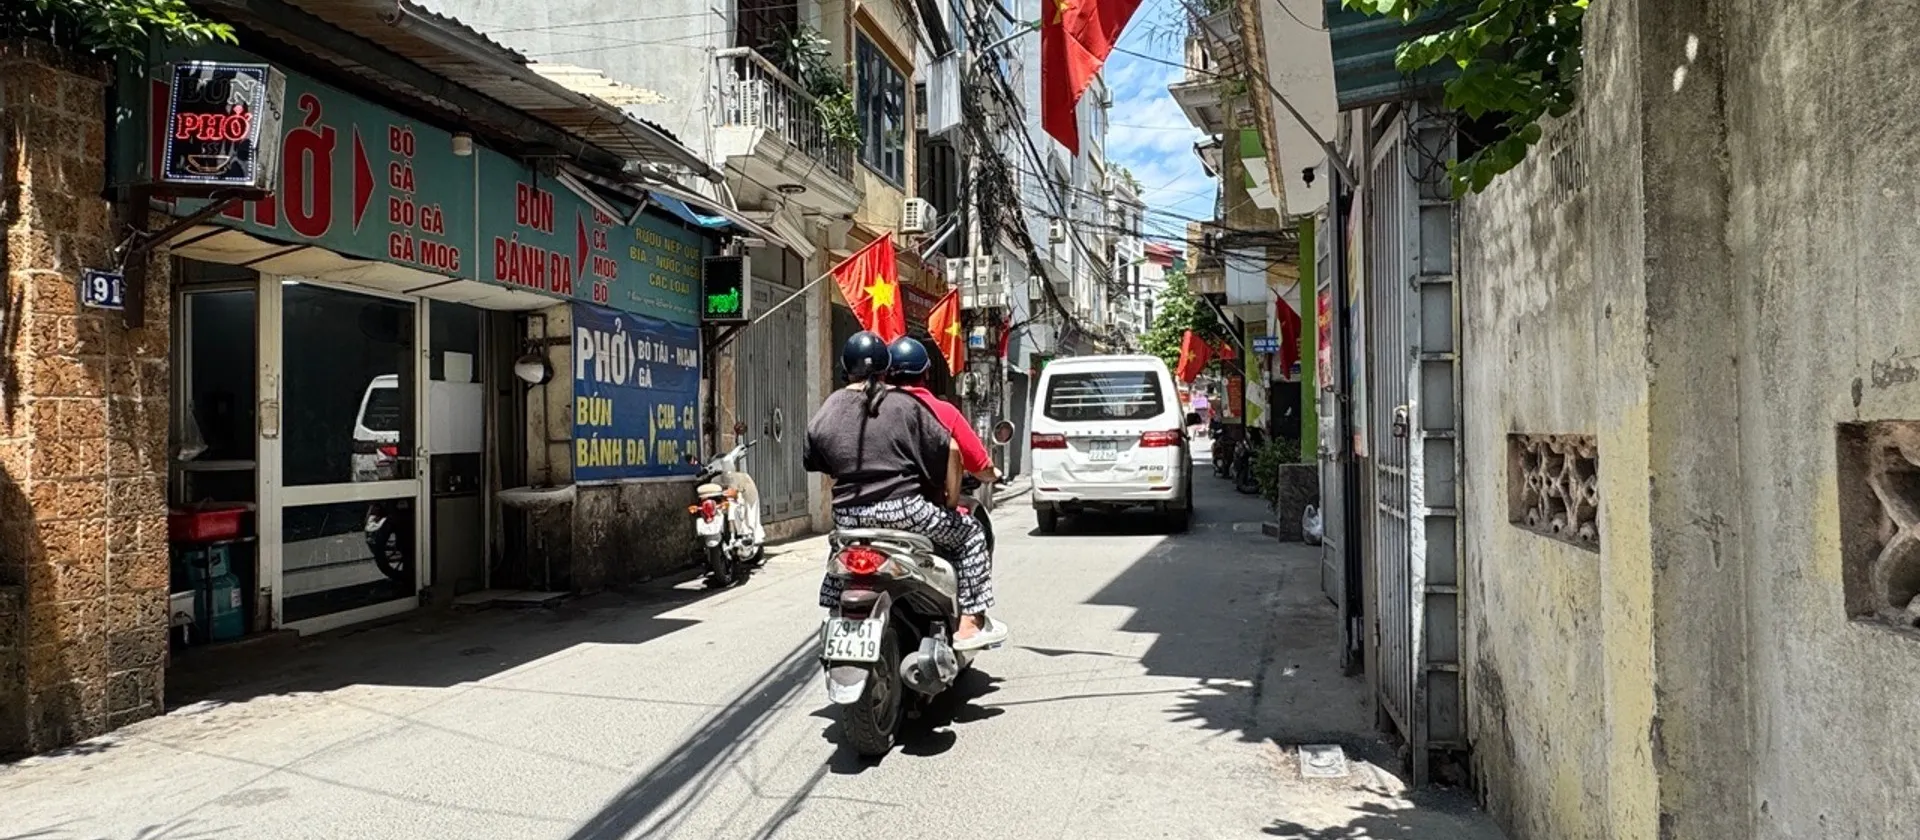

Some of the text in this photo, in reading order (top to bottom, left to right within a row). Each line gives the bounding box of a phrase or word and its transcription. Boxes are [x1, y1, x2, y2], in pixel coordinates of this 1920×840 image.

[388, 124, 416, 158] BÒ
[388, 160, 416, 194] GÀ
[388, 194, 445, 236] BÒ GÀ
[388, 231, 460, 275] GÀ MỌC
[494, 231, 574, 297] BÁNH ĐA
[576, 317, 627, 385] PHỞ
[637, 336, 652, 361] BÒ
[653, 341, 669, 364] TÁI
[638, 364, 653, 388] GÀ
[576, 391, 613, 427] BÚN
[657, 403, 677, 430] CUA
[576, 432, 623, 467] BÁNH
[826, 639, 876, 658] 544.19
